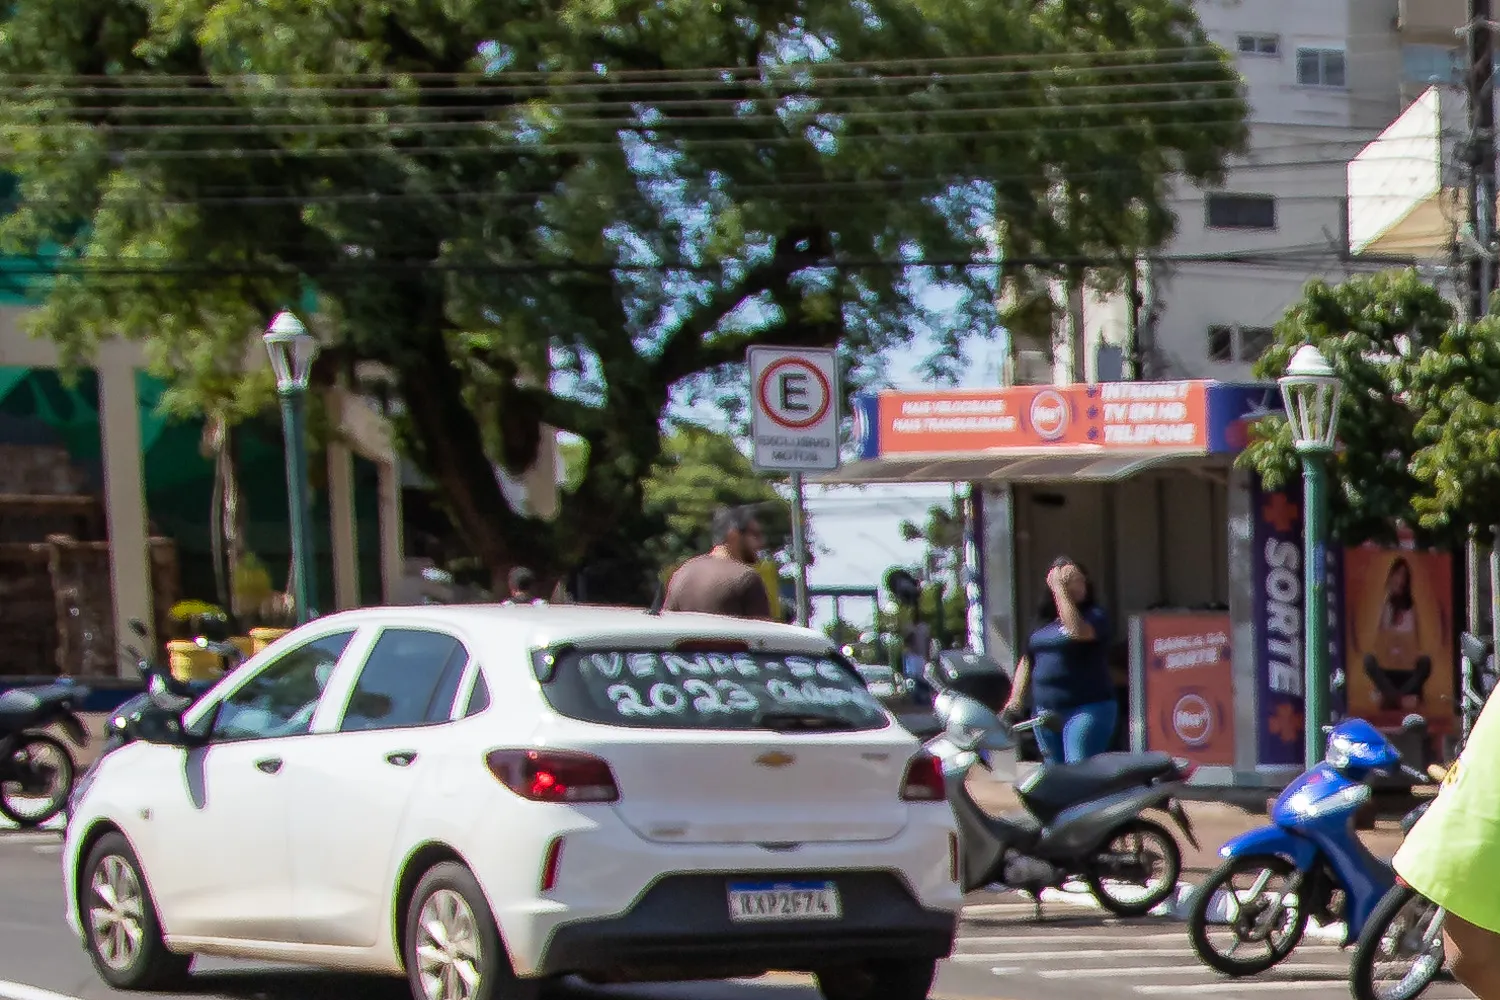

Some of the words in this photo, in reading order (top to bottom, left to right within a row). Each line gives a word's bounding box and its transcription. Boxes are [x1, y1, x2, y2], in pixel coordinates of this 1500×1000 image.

[779, 373, 809, 411] E
[1101, 383, 1190, 400] INTERNET
[902, 400, 931, 414] MAIS
[1104, 402, 1127, 421] TV
[1129, 402, 1156, 420] EM
[1158, 402, 1187, 420] HD
[893, 418, 922, 432] MAIS
[1104, 423, 1196, 443] TELEFONE
[1264, 537, 1300, 696] SORTE
